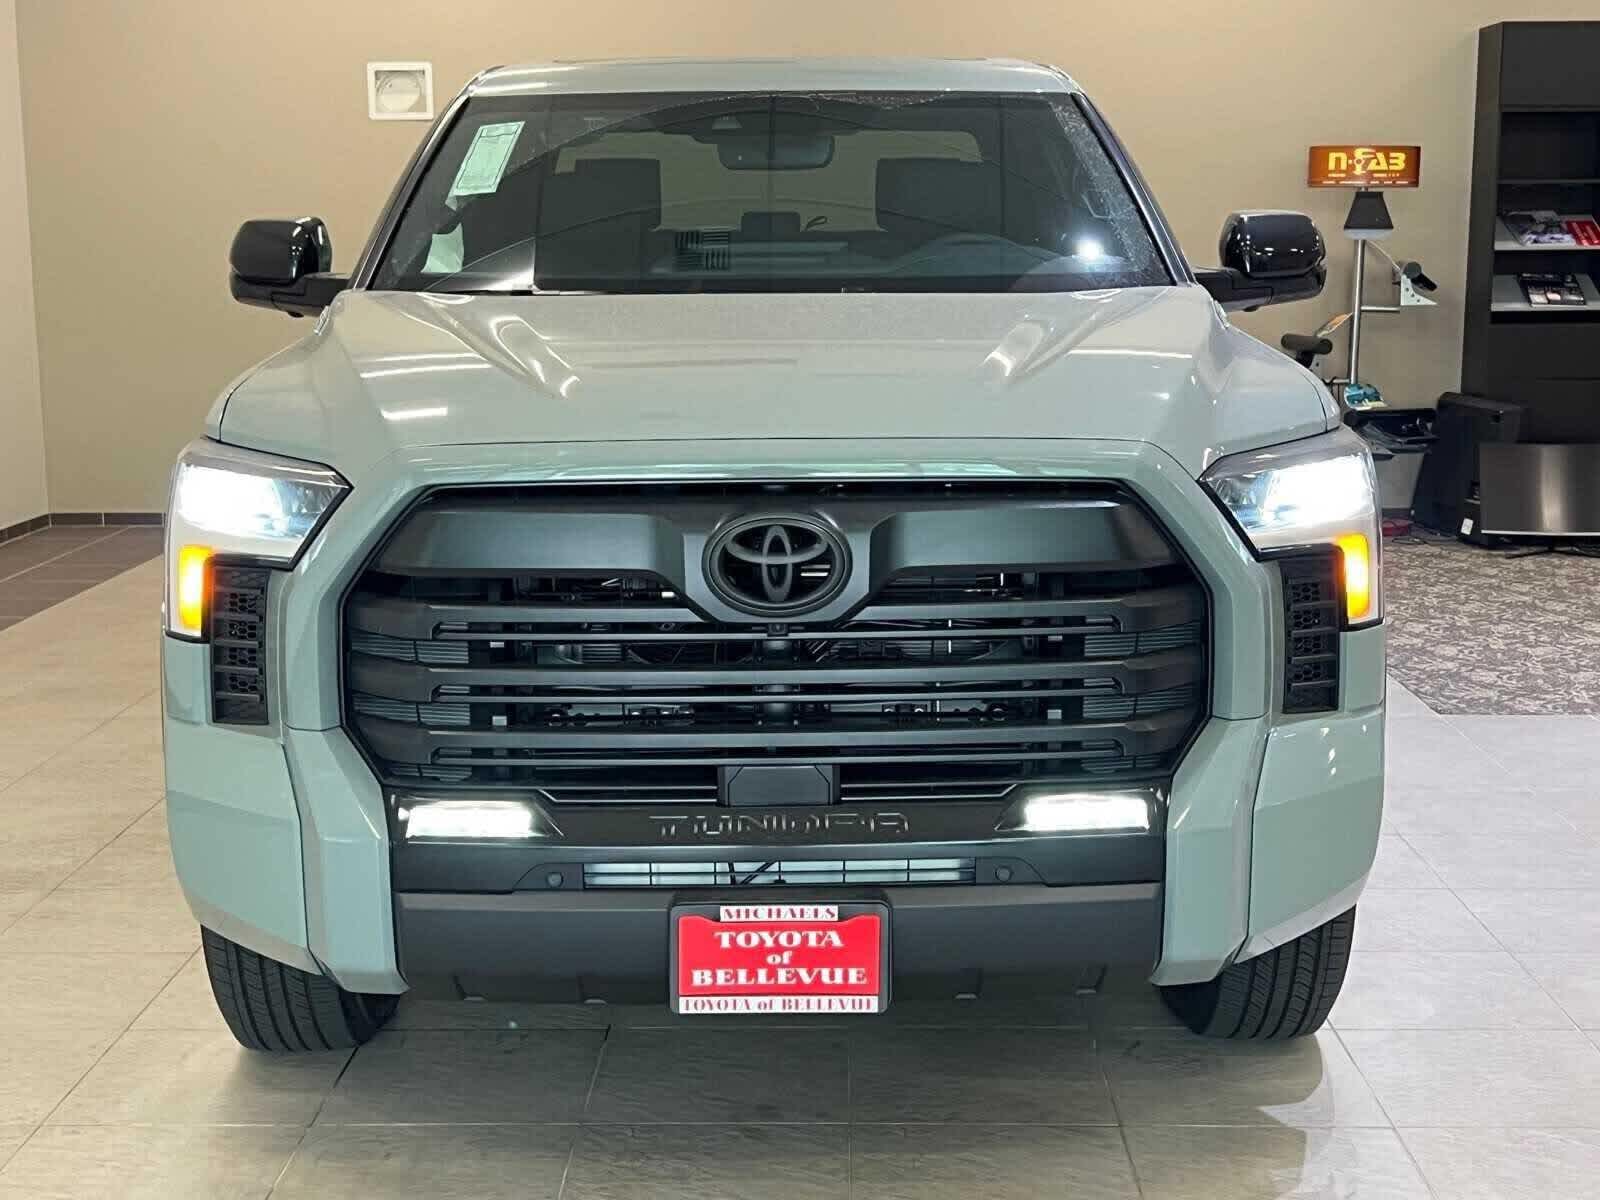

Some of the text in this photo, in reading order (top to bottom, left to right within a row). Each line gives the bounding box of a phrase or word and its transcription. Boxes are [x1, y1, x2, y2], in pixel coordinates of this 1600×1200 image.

[649, 813, 909, 836] TUNDRA
[723, 907, 836, 920] MICHAELS
[714, 931, 843, 948] TOYOTA
[766, 951, 793, 965] of
[691, 968, 867, 987] BELLEVUE
[684, 999, 750, 1011] TOYOTA
[757, 999, 774, 1011] of
